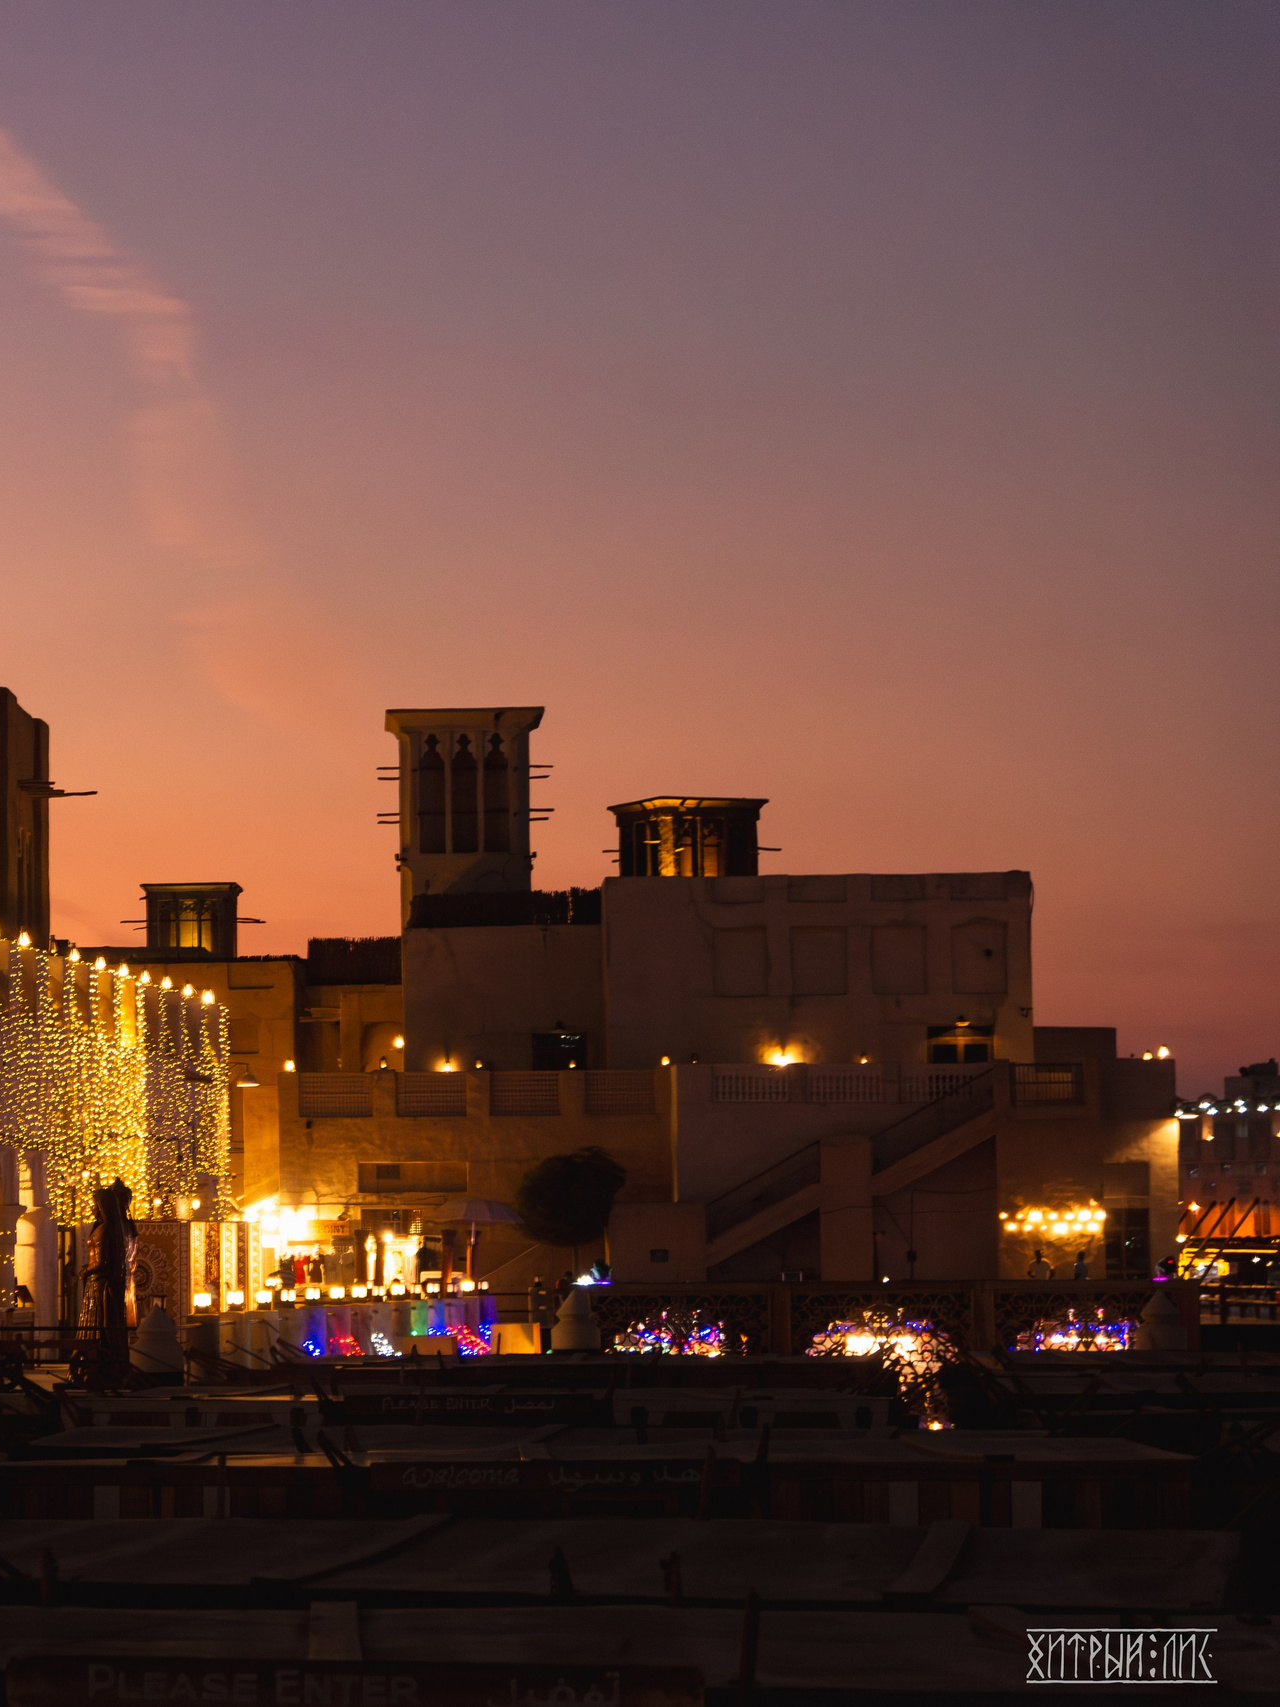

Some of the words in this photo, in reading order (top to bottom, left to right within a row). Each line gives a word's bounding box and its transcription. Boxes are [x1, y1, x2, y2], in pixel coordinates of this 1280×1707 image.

[445, 1396, 495, 1412] ENTER
[88, 1662, 258, 1703] PLEASE
[274, 1668, 421, 1706] ENTER
